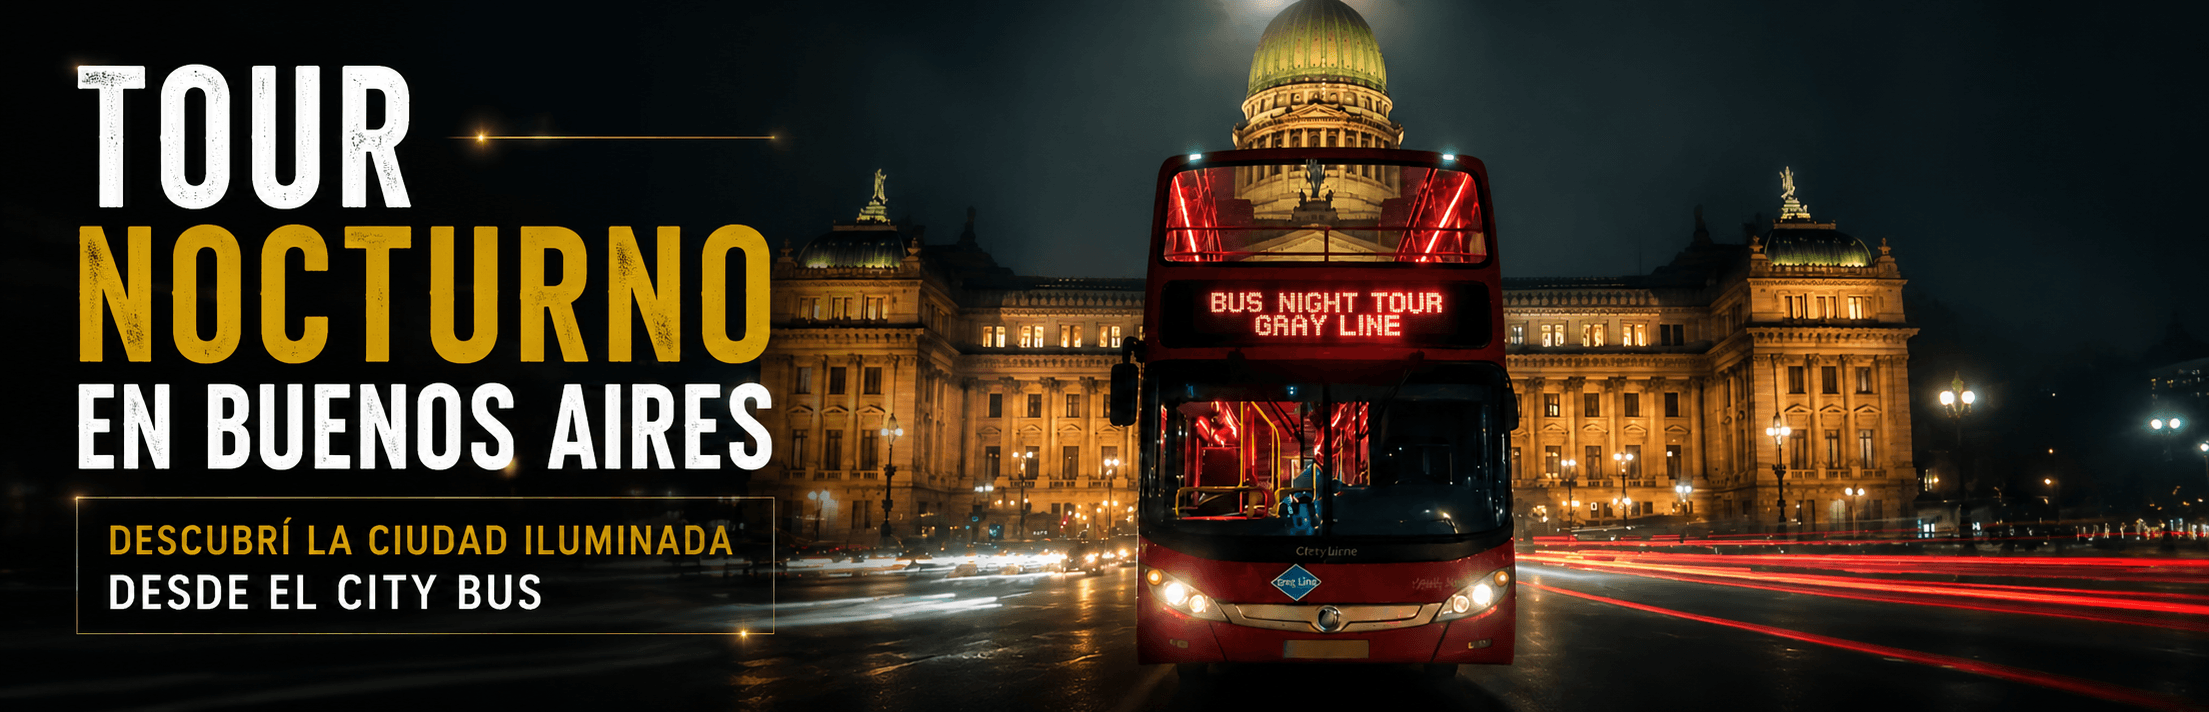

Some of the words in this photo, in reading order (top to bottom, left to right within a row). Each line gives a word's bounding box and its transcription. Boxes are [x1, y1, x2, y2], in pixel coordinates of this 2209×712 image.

[1211, 292, 1262, 313] BUS
[1279, 292, 1358, 313] NIGHT
[1371, 292, 1442, 313] TOUR
[1255, 315, 1327, 336] GRAY
[1340, 315, 1400, 336] LINE
